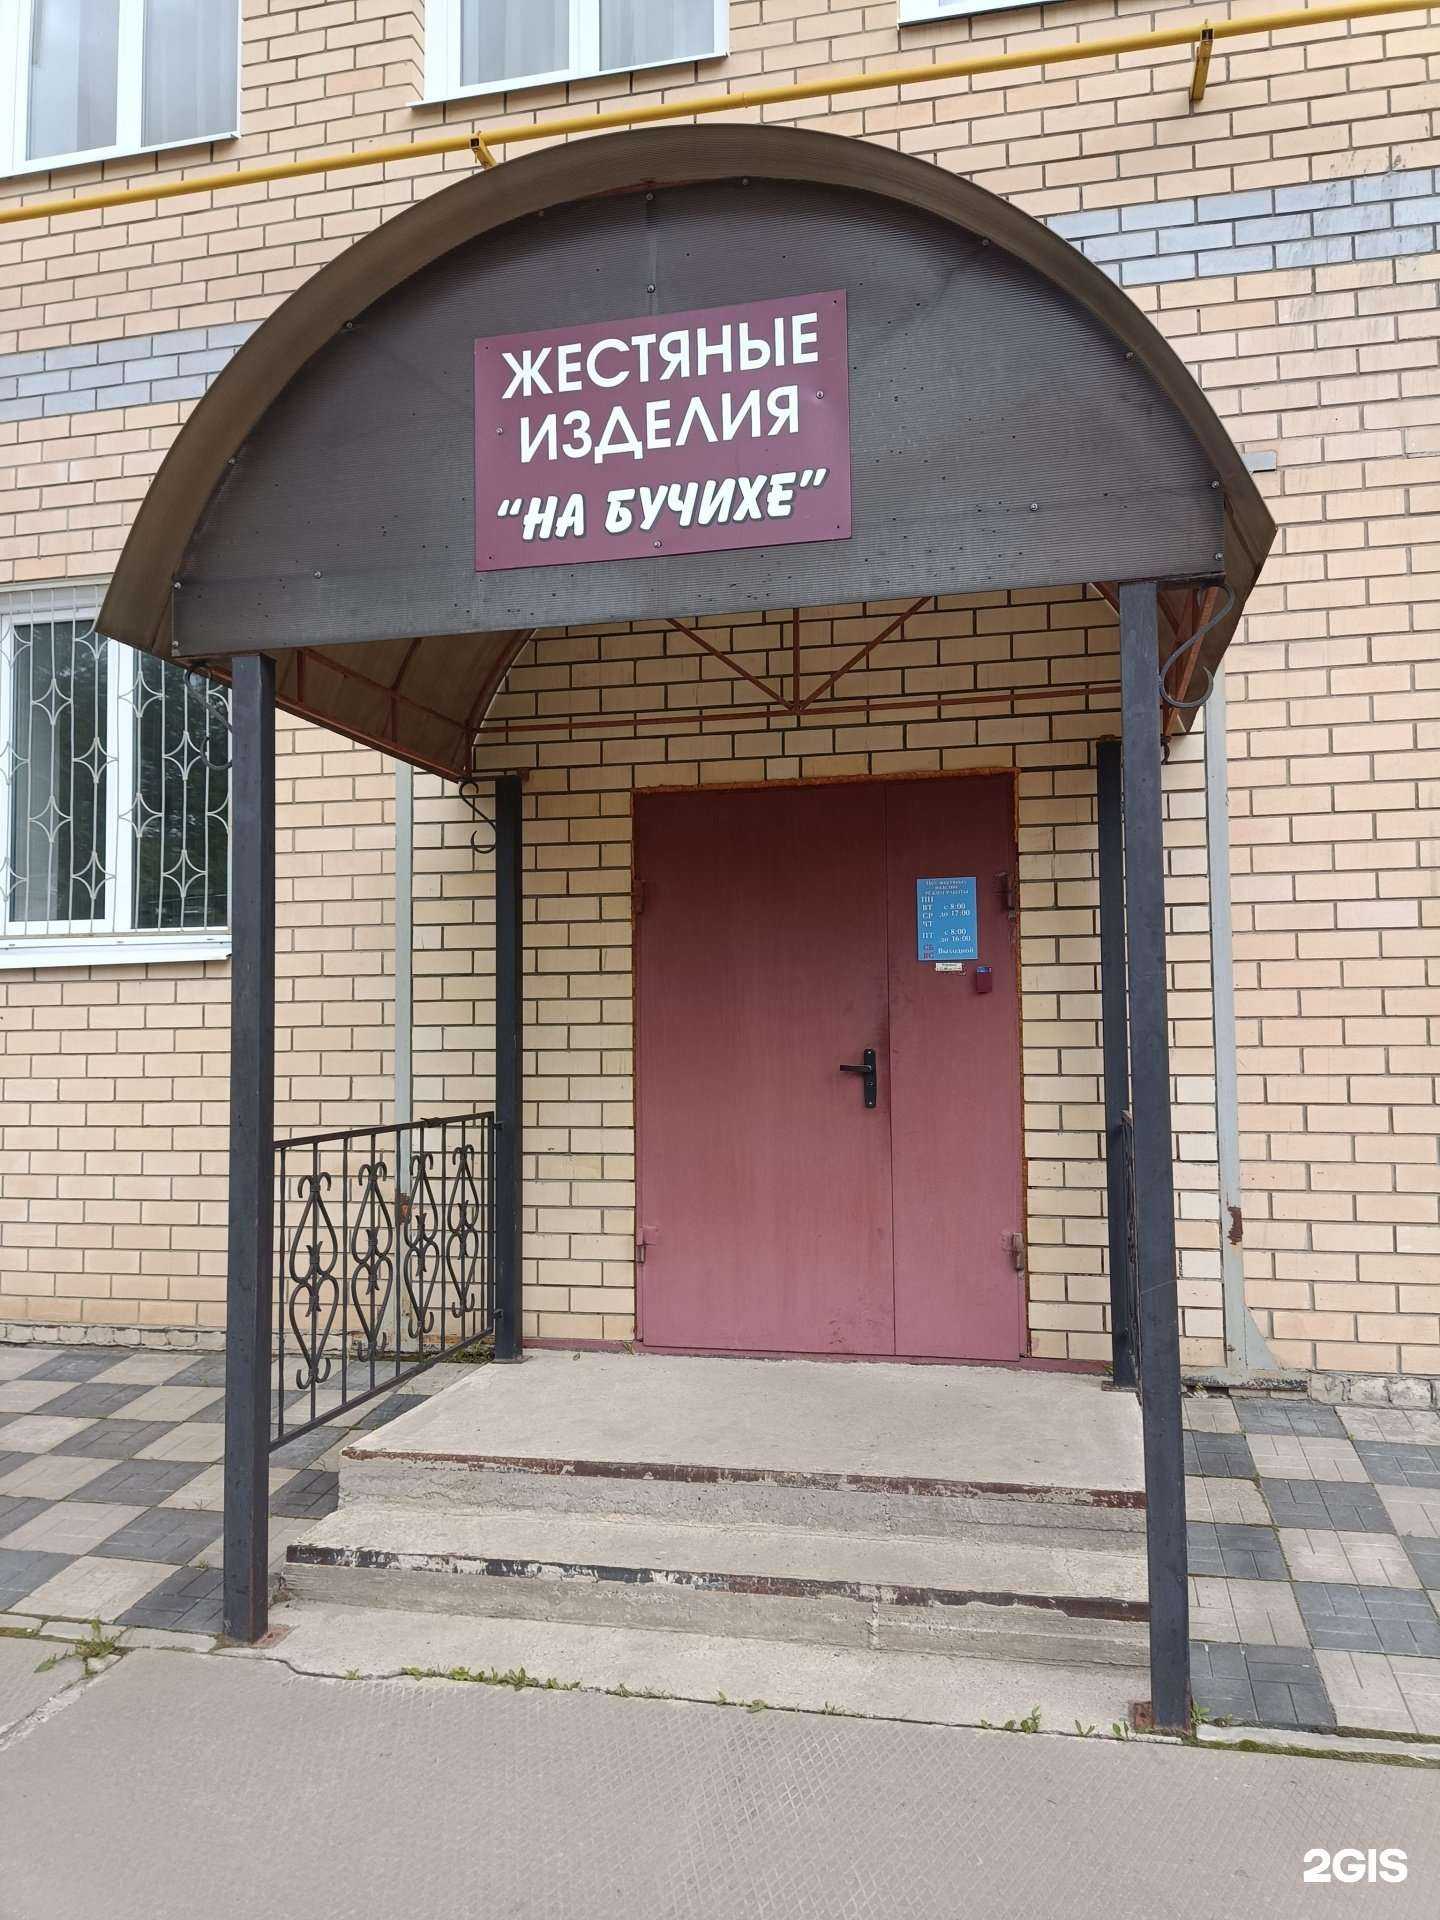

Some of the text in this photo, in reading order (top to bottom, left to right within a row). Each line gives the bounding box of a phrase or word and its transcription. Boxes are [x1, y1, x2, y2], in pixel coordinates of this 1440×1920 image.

[501, 312, 819, 399] ЖЕСТЯНЫЕ
[520, 385, 799, 464] ИЗДЕЛИЯ
[496, 467, 828, 540] "НА БУЧИХЕ"
[951, 909, 970, 917] 17:00
